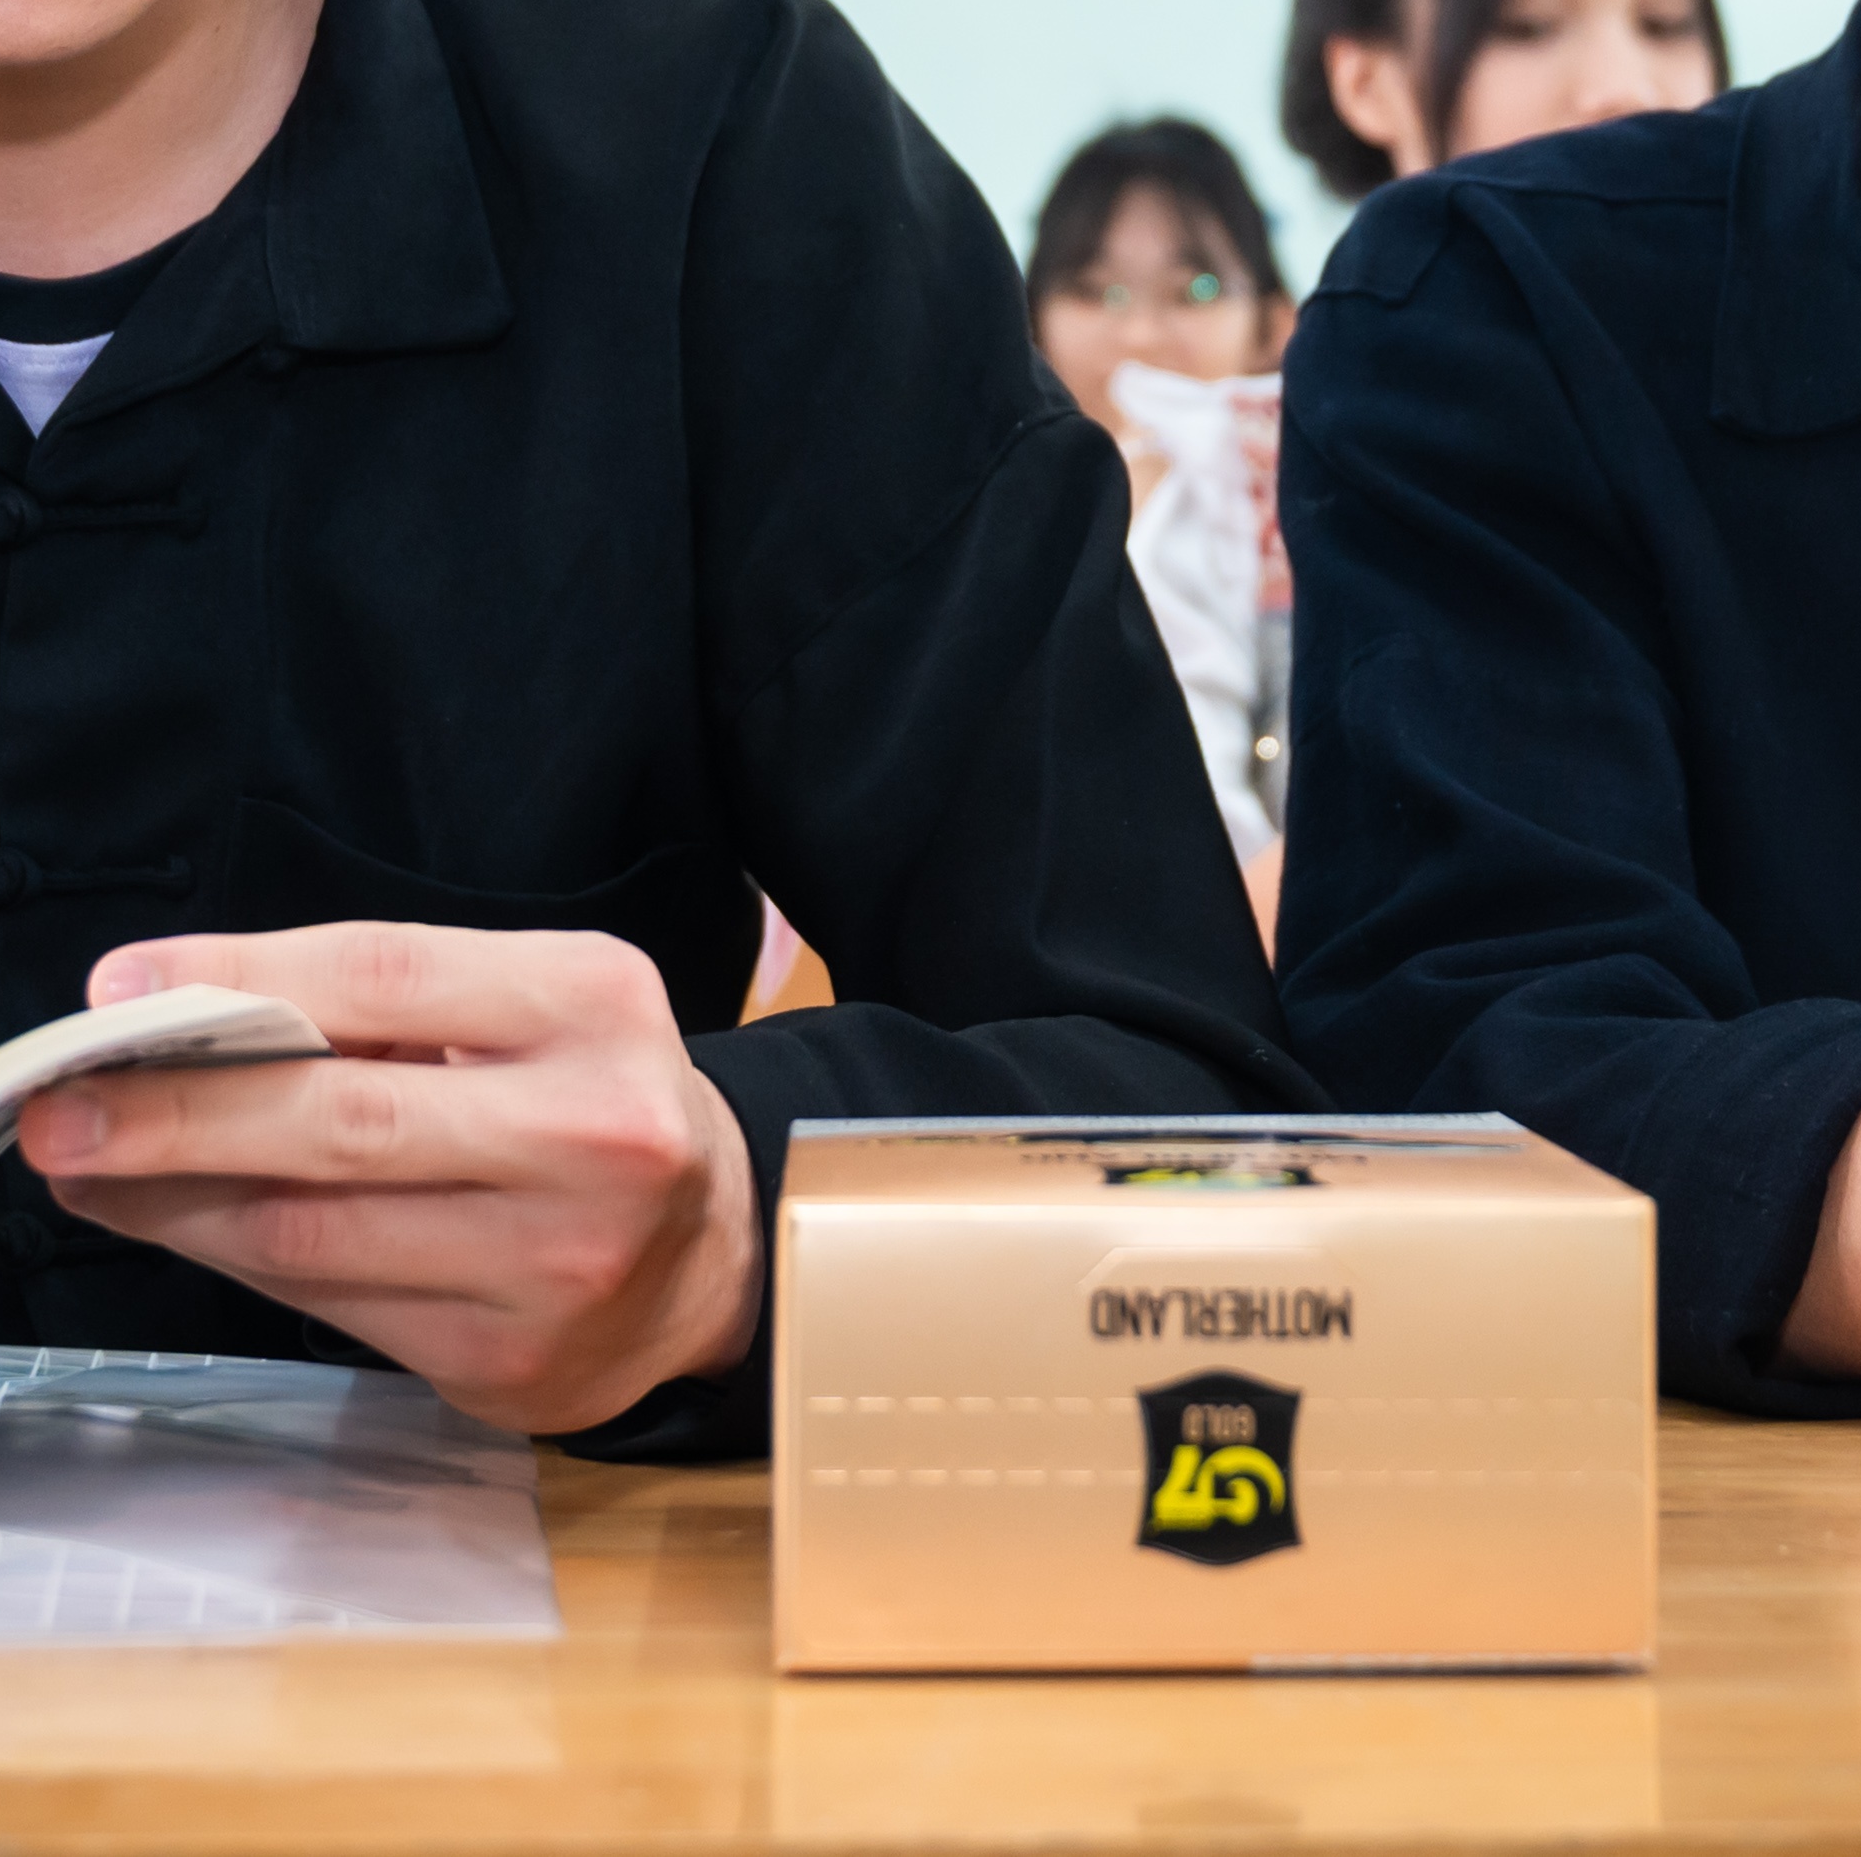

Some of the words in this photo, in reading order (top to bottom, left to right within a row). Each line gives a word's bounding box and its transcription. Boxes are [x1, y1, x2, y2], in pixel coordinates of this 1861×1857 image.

[1090, 1288, 1351, 1338] MOTHERLAND
[1181, 1404, 1256, 1442] GOLD
[1152, 1444, 1286, 1530] G7
